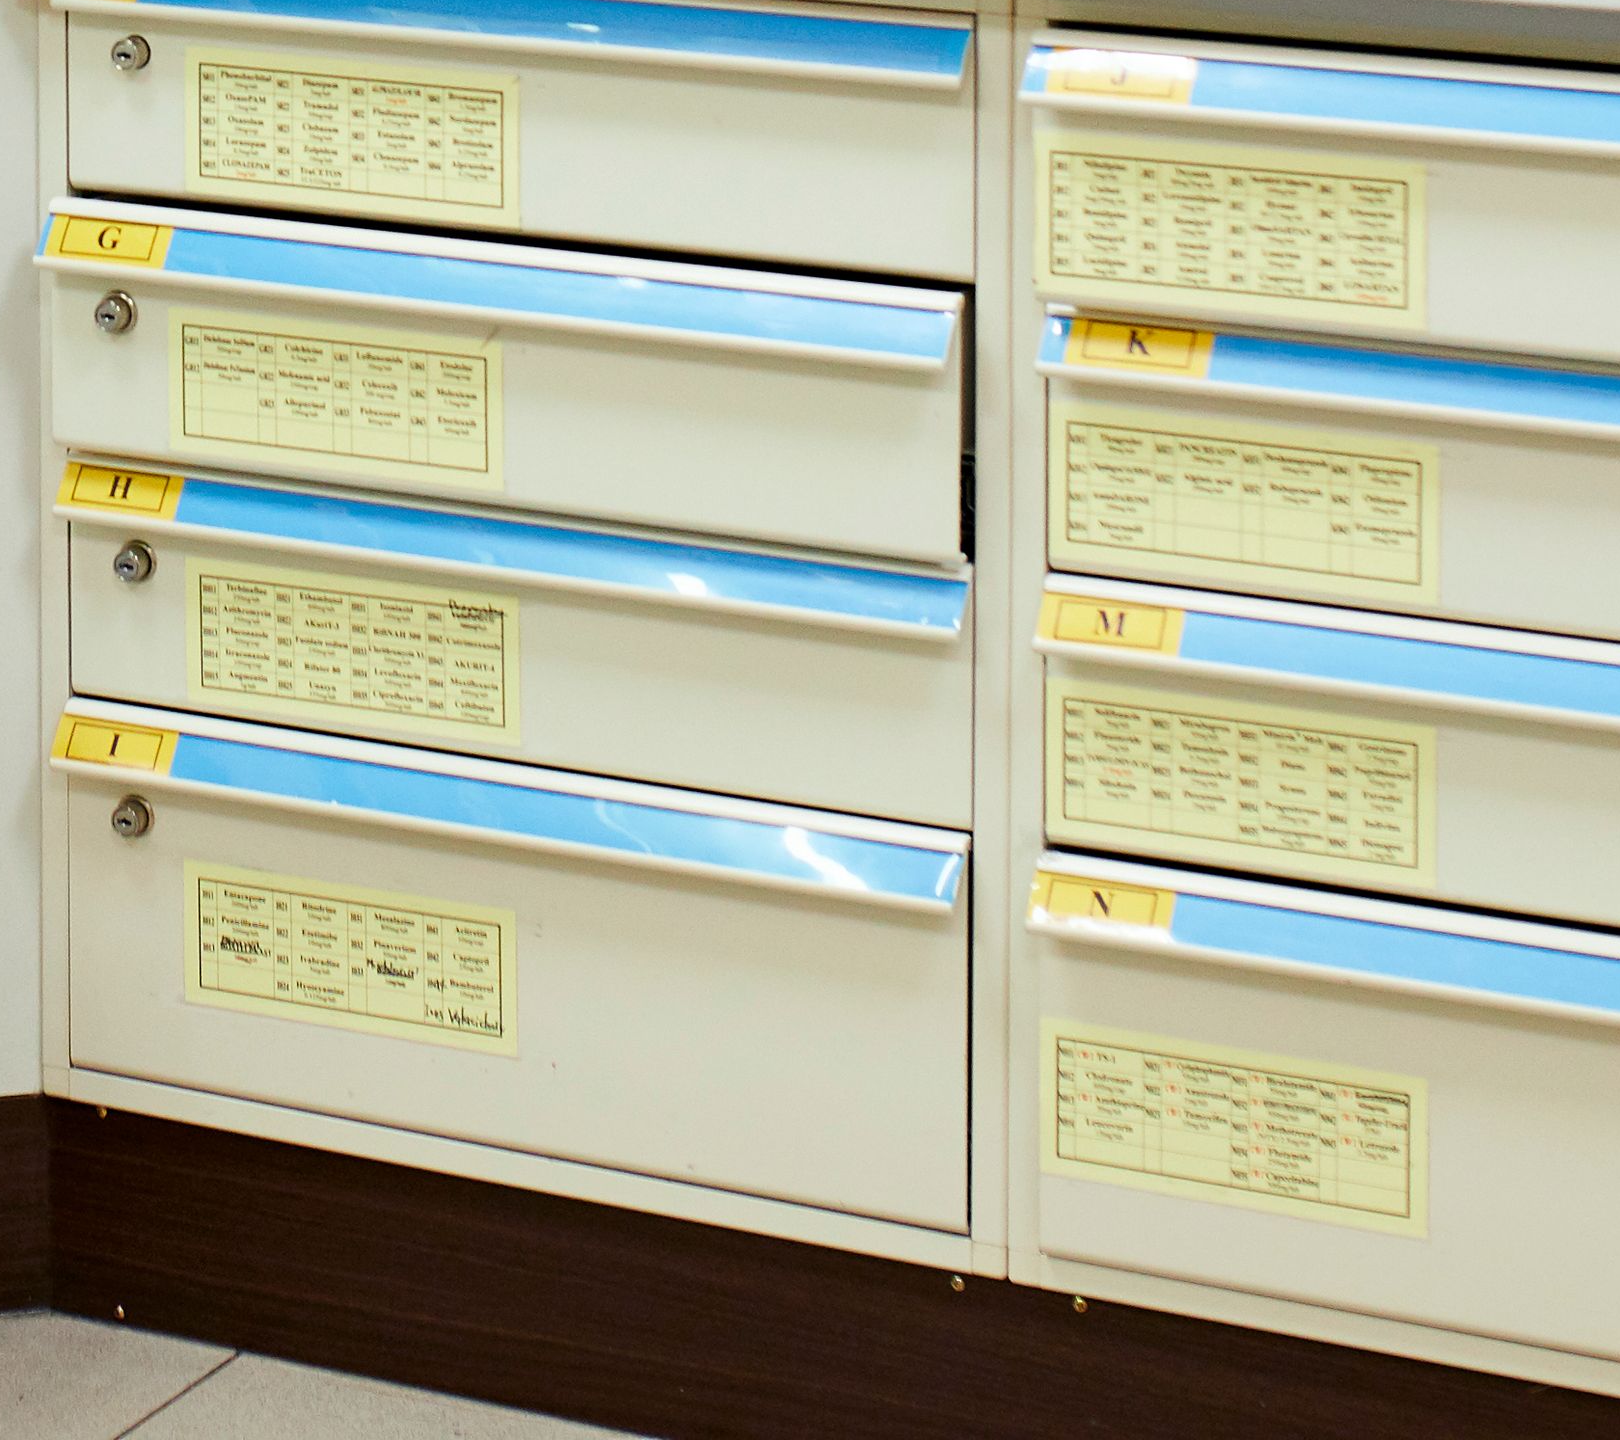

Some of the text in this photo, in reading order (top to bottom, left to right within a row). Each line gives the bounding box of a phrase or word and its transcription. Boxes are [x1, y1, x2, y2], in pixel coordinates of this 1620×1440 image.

[98, 229, 120, 251] G
[108, 476, 132, 498] H
[1094, 609, 1127, 637] M
[109, 734, 120, 756] I
[1091, 891, 1112, 917] N
